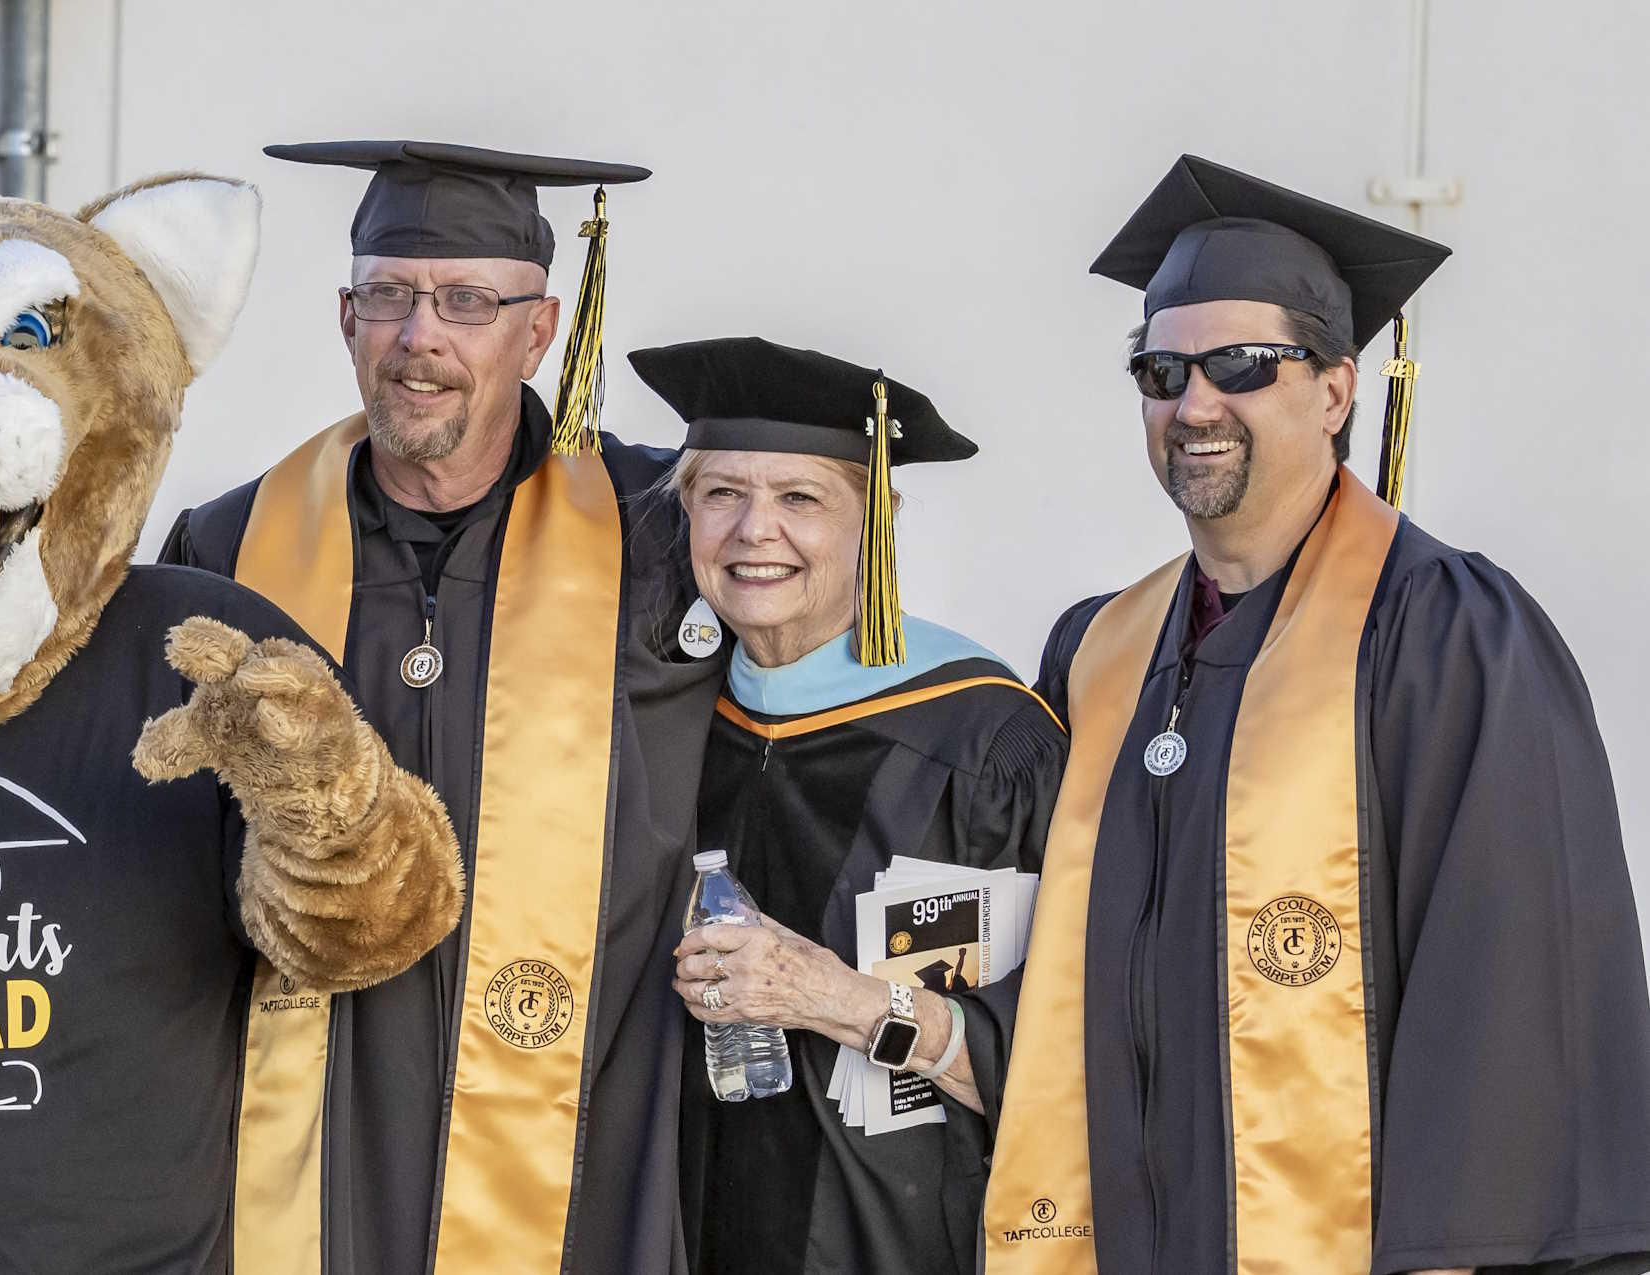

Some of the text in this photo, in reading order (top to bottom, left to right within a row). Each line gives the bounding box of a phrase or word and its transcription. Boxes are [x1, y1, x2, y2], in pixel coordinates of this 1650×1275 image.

[912, 891, 979, 926] 99th ANNUAL
[982, 887, 991, 943] COMMENCEMENT
[1251, 899, 1337, 939] TAFT COLLEGE
[490, 963, 570, 1004] TAFT COLLEGE
[1257, 954, 1334, 984] CARPE DIEM
[491, 1014, 564, 1046] CARPE DIEM
[1003, 1226, 1091, 1242] TAFTCOLLEGE
